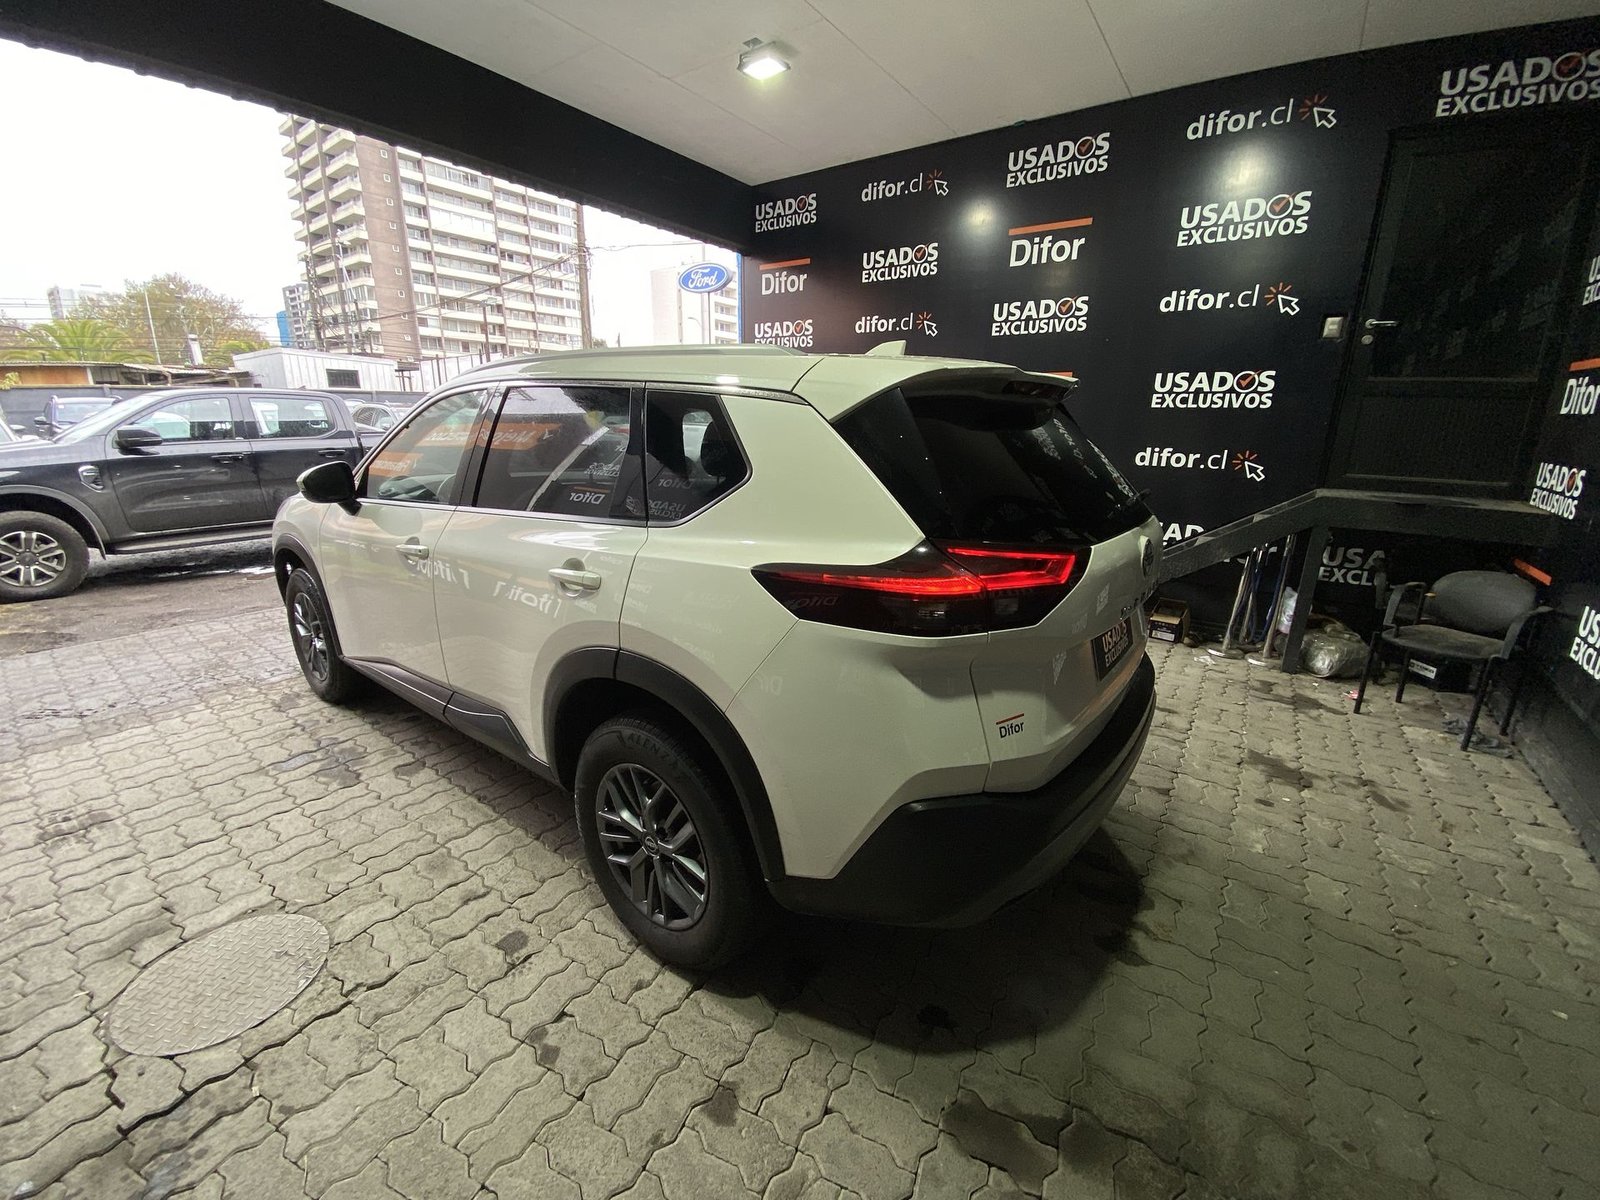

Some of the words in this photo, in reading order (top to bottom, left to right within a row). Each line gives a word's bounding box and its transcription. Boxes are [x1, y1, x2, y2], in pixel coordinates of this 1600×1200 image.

[1440, 50, 1600, 97] USADOS
[1186, 98, 1294, 141] difor.cl
[1008, 132, 1111, 172] USADOS
[1006, 155, 1109, 188] EXCLUSIVOS
[861, 173, 923, 202] difor.cl
[755, 193, 817, 220] USADOS
[1180, 190, 1312, 230] USADOS
[755, 211, 817, 233] EXCLUSIVOS
[1176, 216, 1309, 247] EXCLUSIVOS
[862, 242, 939, 269] USADOS
[1009, 235, 1086, 268] Difor
[688, 268, 718, 289] Ford
[761, 271, 807, 296] Difor
[861, 261, 938, 283] EXCLUSIVOS
[993, 296, 1089, 322] USADOS
[1159, 283, 1260, 313] difor.cl
[754, 319, 813, 338] USADOS
[855, 312, 913, 335] difor.cl
[991, 317, 1088, 337] EXCLUSIVOS
[1155, 370, 1276, 393] USADOS
[1150, 393, 1272, 409] EXCLUSIVOS
[1560, 376, 1600, 415] Difor
[1134, 447, 1228, 470] difor.cl
[1535, 462, 1587, 498] USADOS
[1530, 488, 1579, 520] EXCLUSIVOS
[1102, 621, 1128, 653] USADS
[999, 722, 1024, 738] Difor
